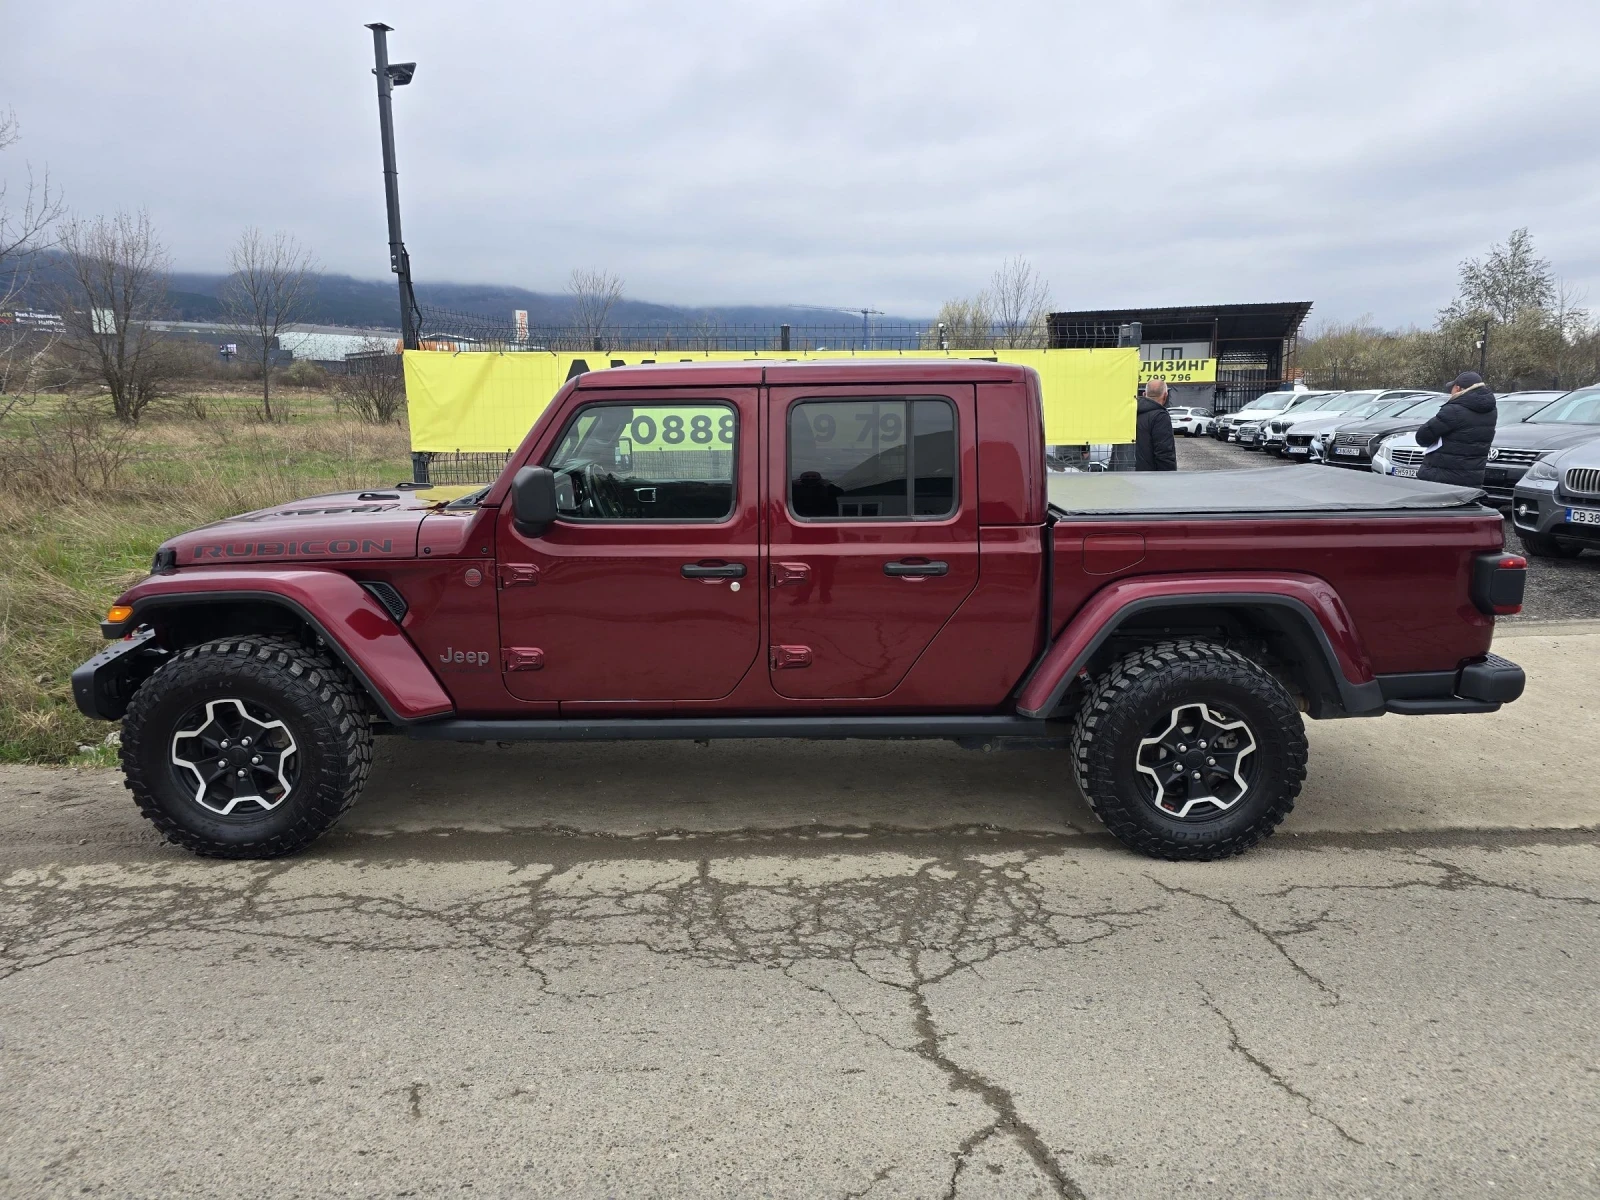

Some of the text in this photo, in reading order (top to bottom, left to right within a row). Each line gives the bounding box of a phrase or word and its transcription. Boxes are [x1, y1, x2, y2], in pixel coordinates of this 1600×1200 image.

[1140, 360, 1209, 372] ЛИЗИНГ
[1146, 374, 1166, 382] 799
[1170, 373, 1191, 381] 796
[631, 412, 902, 445] 0888 9 79
[1572, 511, 1586, 522] CB
[194, 539, 393, 559] RUBICON
[440, 647, 490, 666] Jeep
